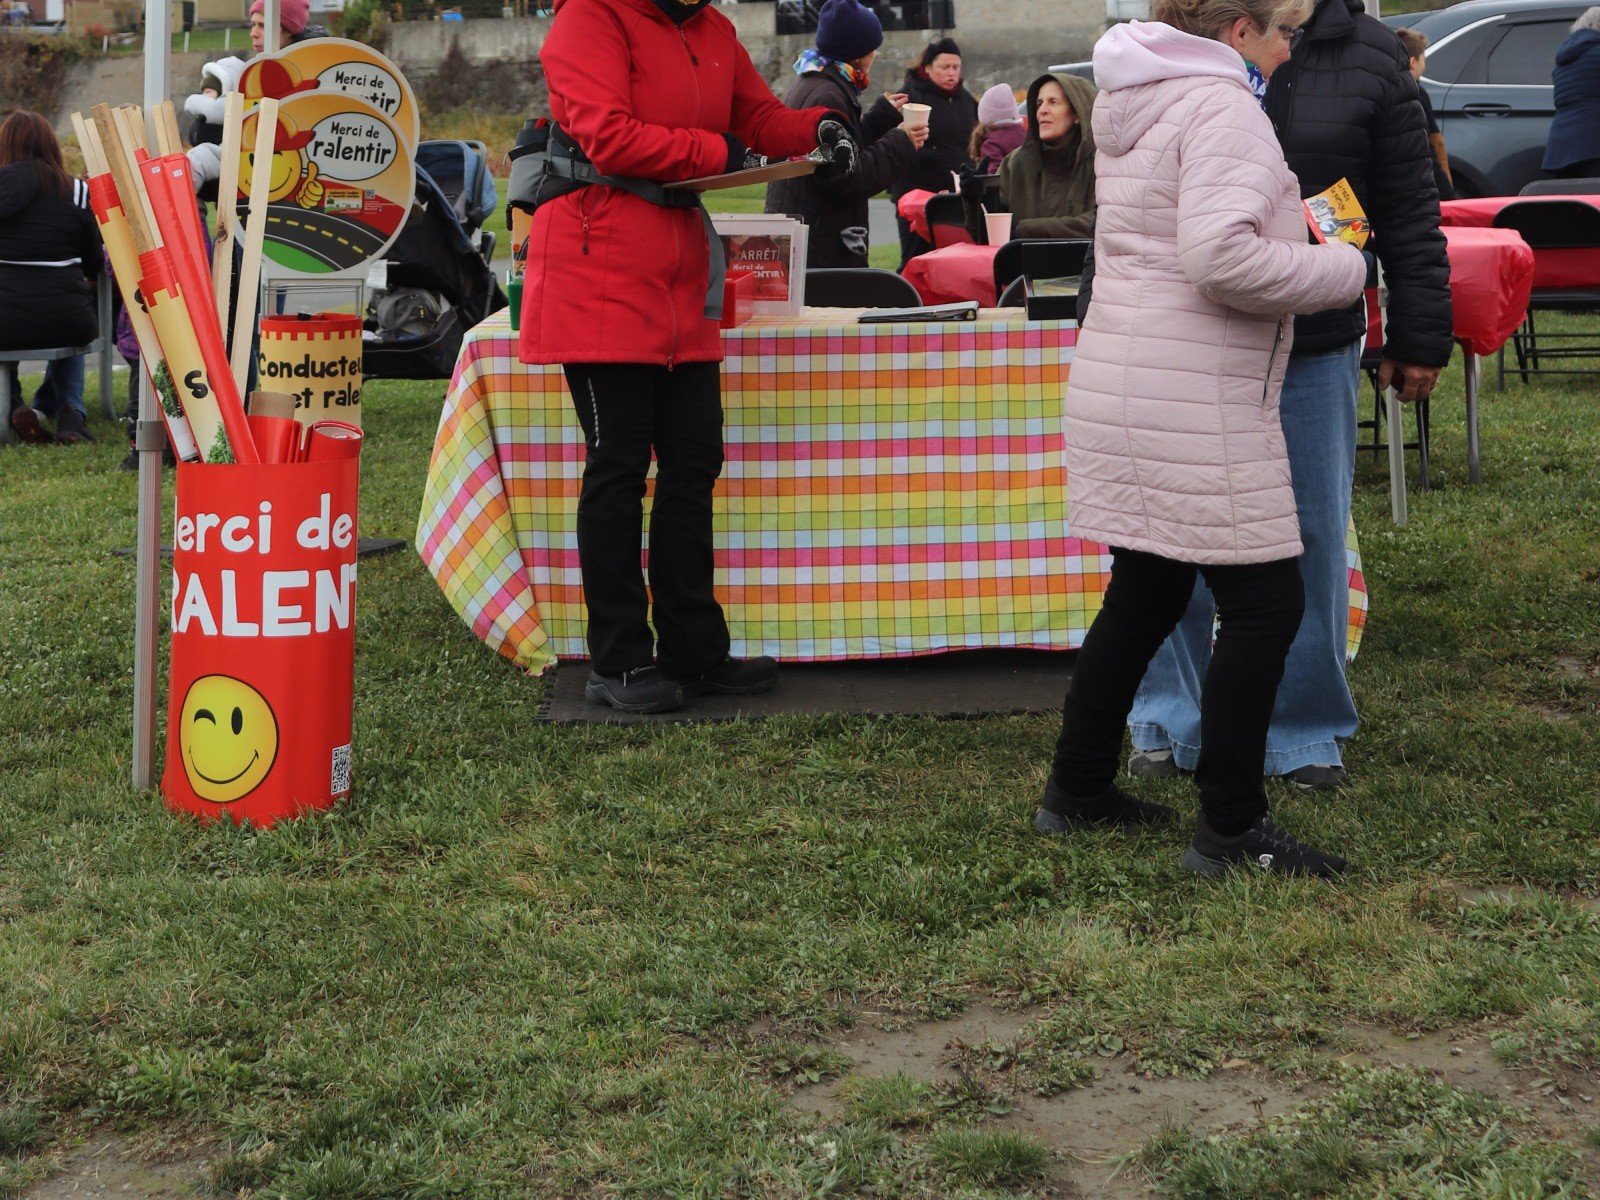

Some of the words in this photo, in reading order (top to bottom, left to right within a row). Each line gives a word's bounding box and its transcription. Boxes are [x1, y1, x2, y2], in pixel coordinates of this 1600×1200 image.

[335, 70, 367, 87] Merci
[370, 75, 385, 89] de
[330, 120, 363, 137] Merci
[366, 125, 380, 139] de
[312, 136, 392, 165] ralentir
[741, 248, 777, 260] ARRÊT
[323, 381, 361, 409] rale
[174, 495, 272, 554] erci
[296, 492, 353, 550] de
